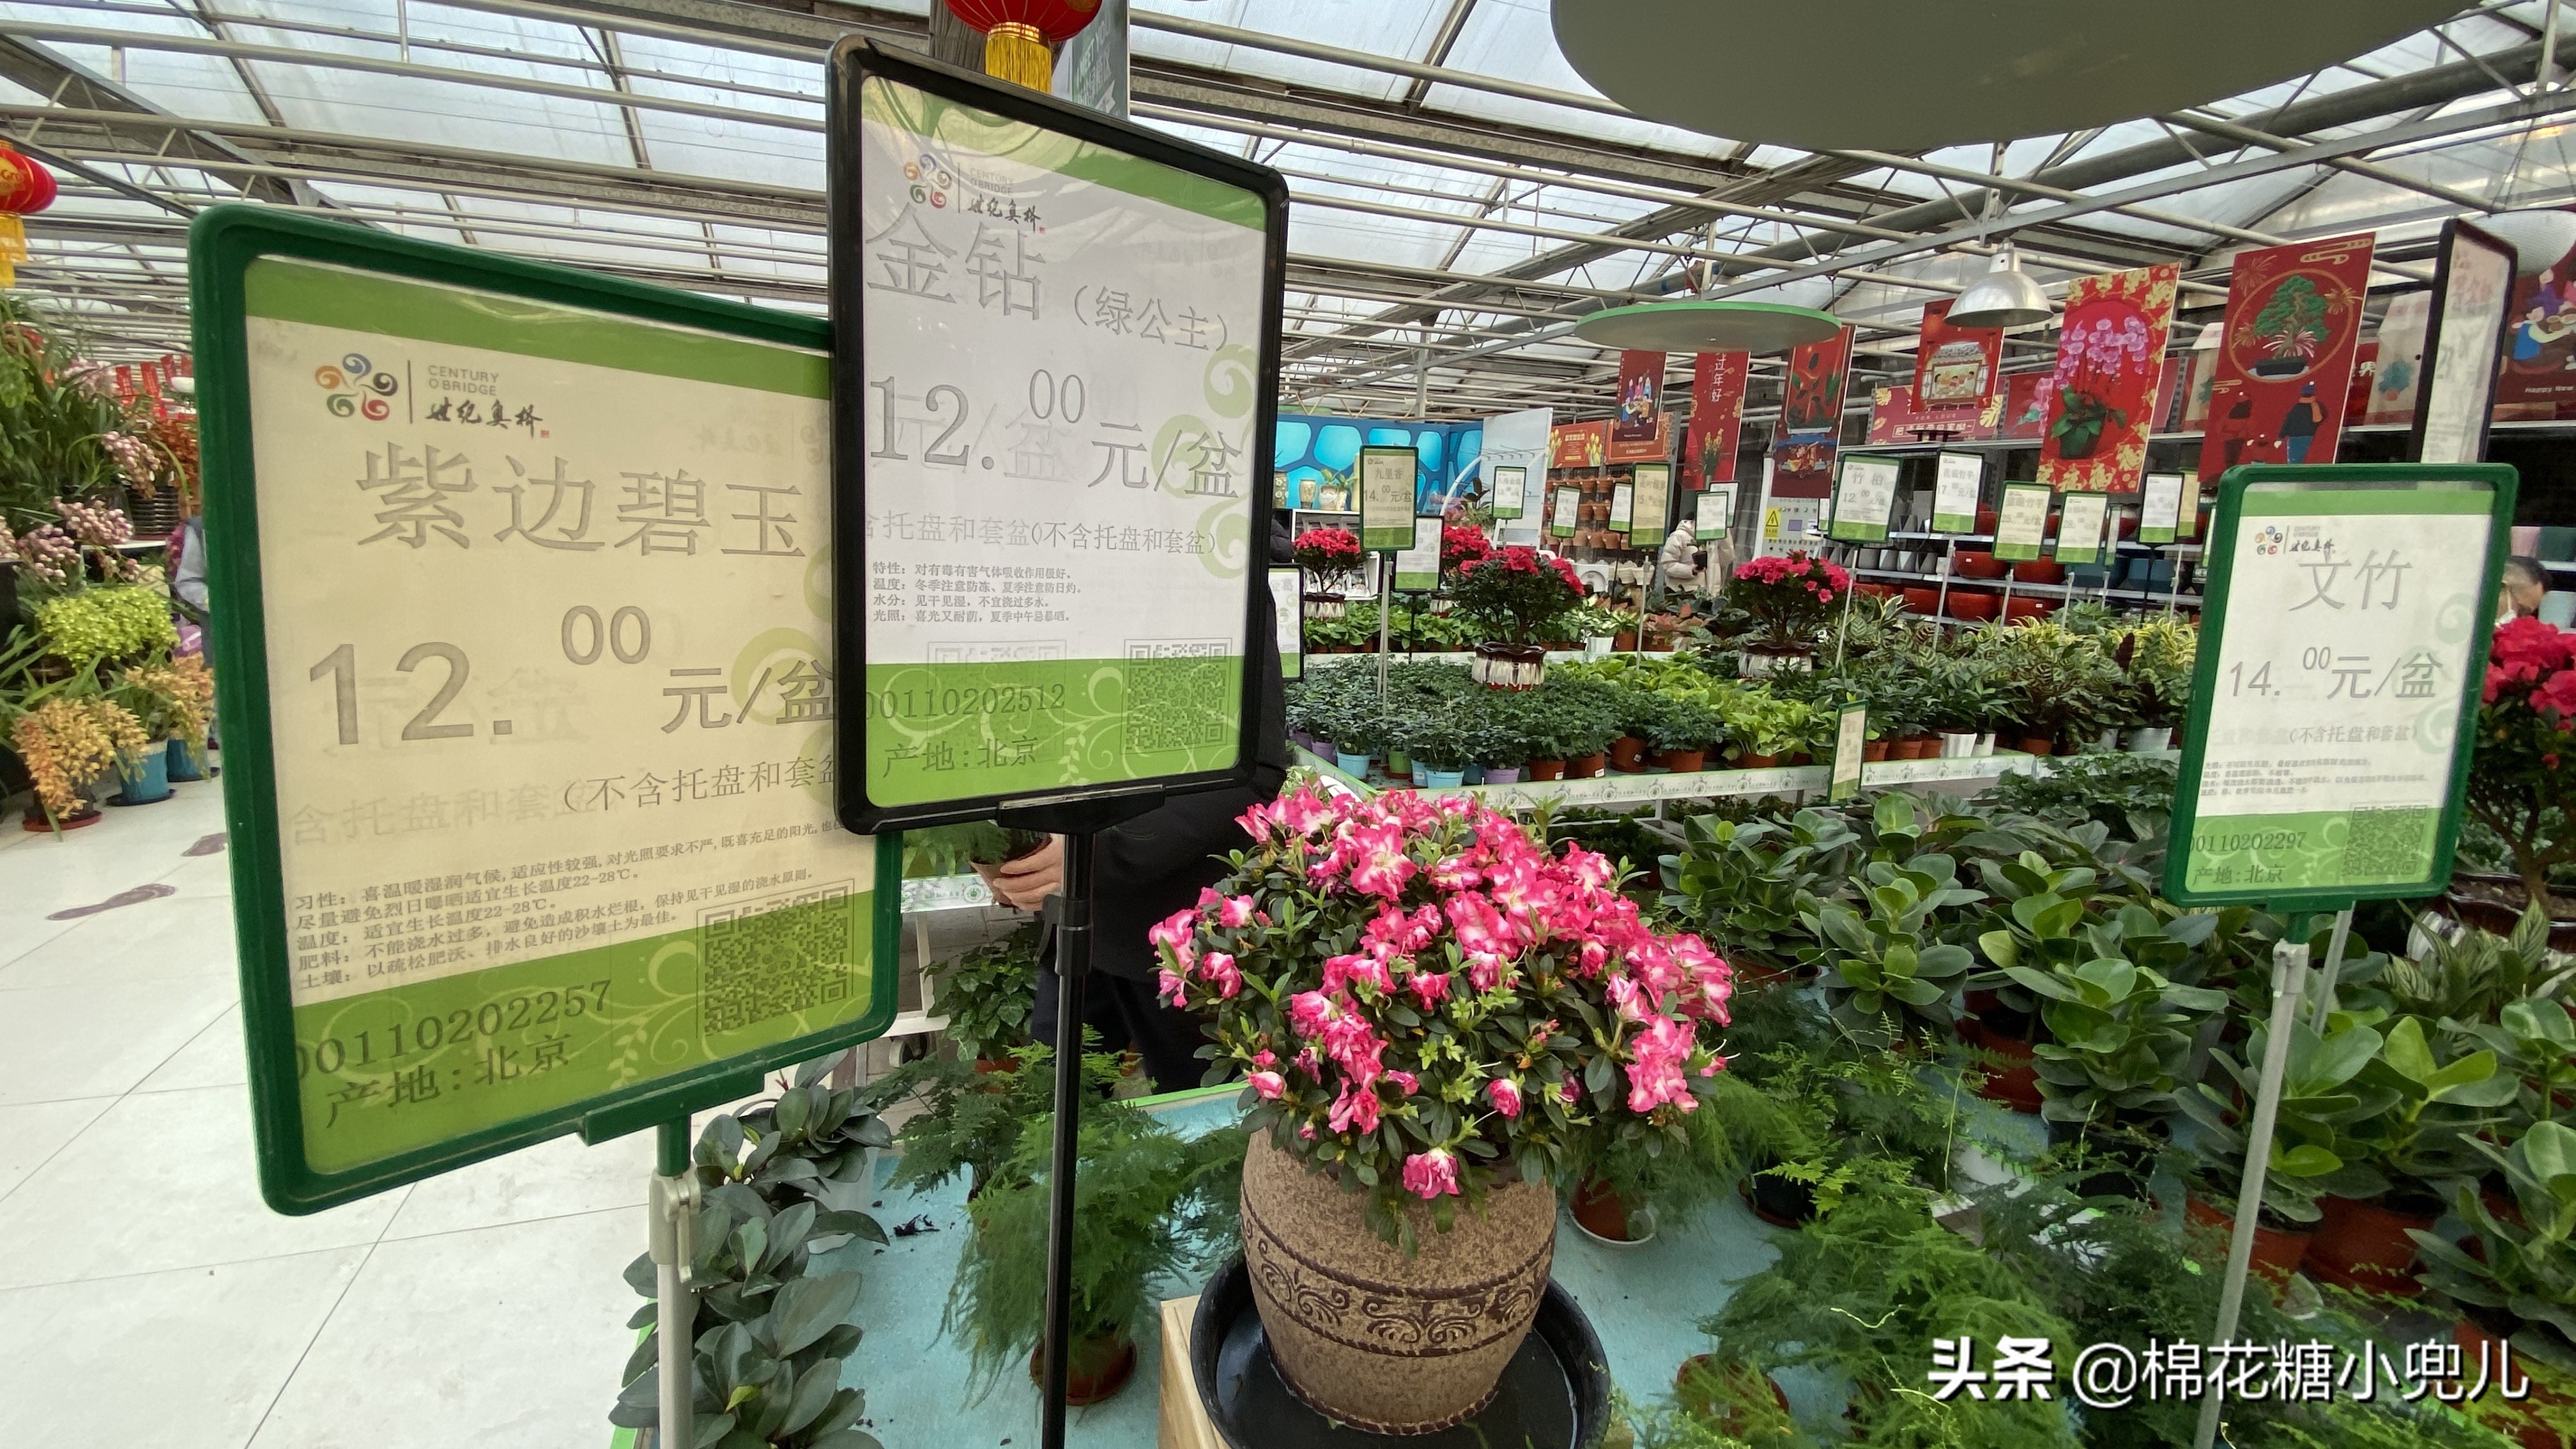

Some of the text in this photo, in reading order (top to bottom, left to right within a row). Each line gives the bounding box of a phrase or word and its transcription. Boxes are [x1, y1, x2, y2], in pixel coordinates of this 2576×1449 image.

[865, 201, 1229, 351] 金钻 （绿公主）
[427, 365, 500, 383] CENTURY
[424, 396, 543, 440] 世纪奥桥
[356, 443, 806, 558] 紫边碧玉
[1375, 468, 1403, 480] 九里香
[2288, 549, 2413, 611] 文竹
